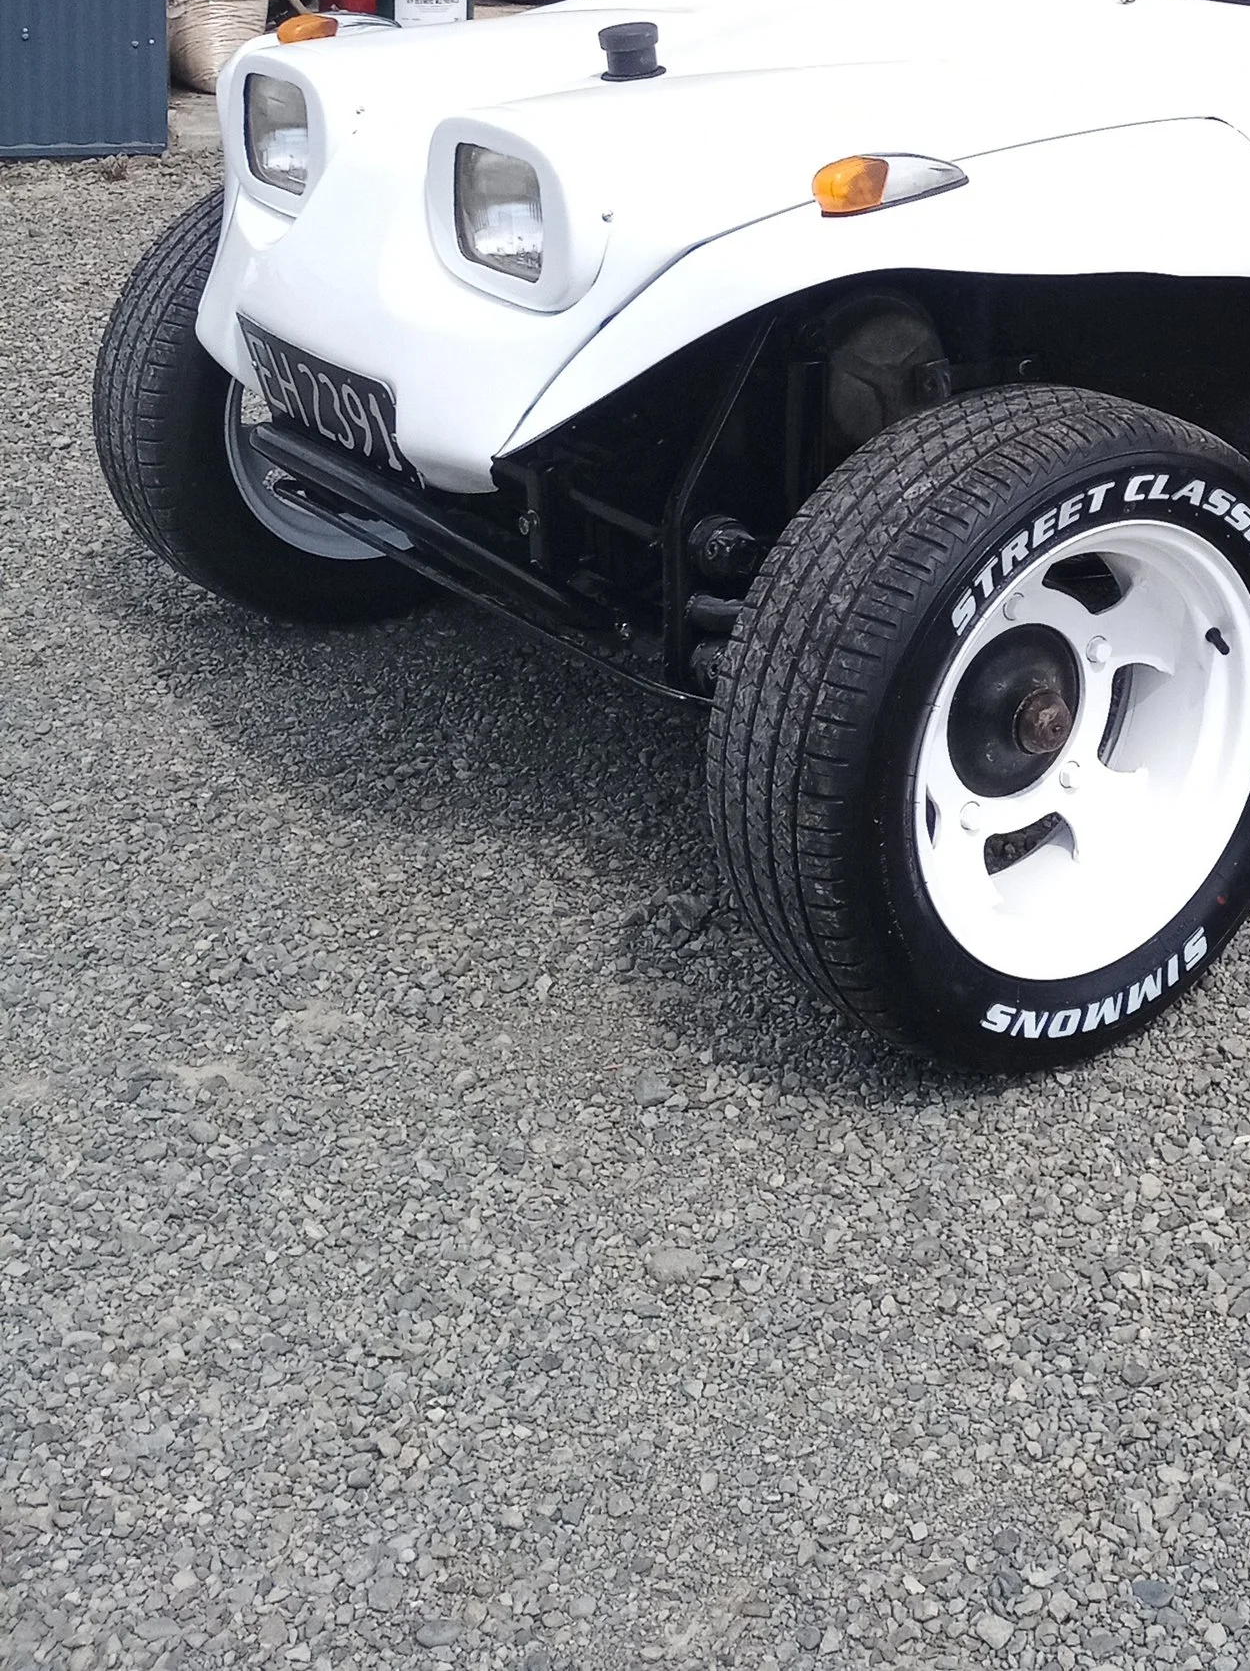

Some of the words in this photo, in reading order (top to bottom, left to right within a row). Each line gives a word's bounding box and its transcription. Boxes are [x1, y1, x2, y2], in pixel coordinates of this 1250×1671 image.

[245, 330, 403, 472] EH2391
[951, 481, 1116, 636] STREET
[979, 926, 1209, 1040] SIMMONS
